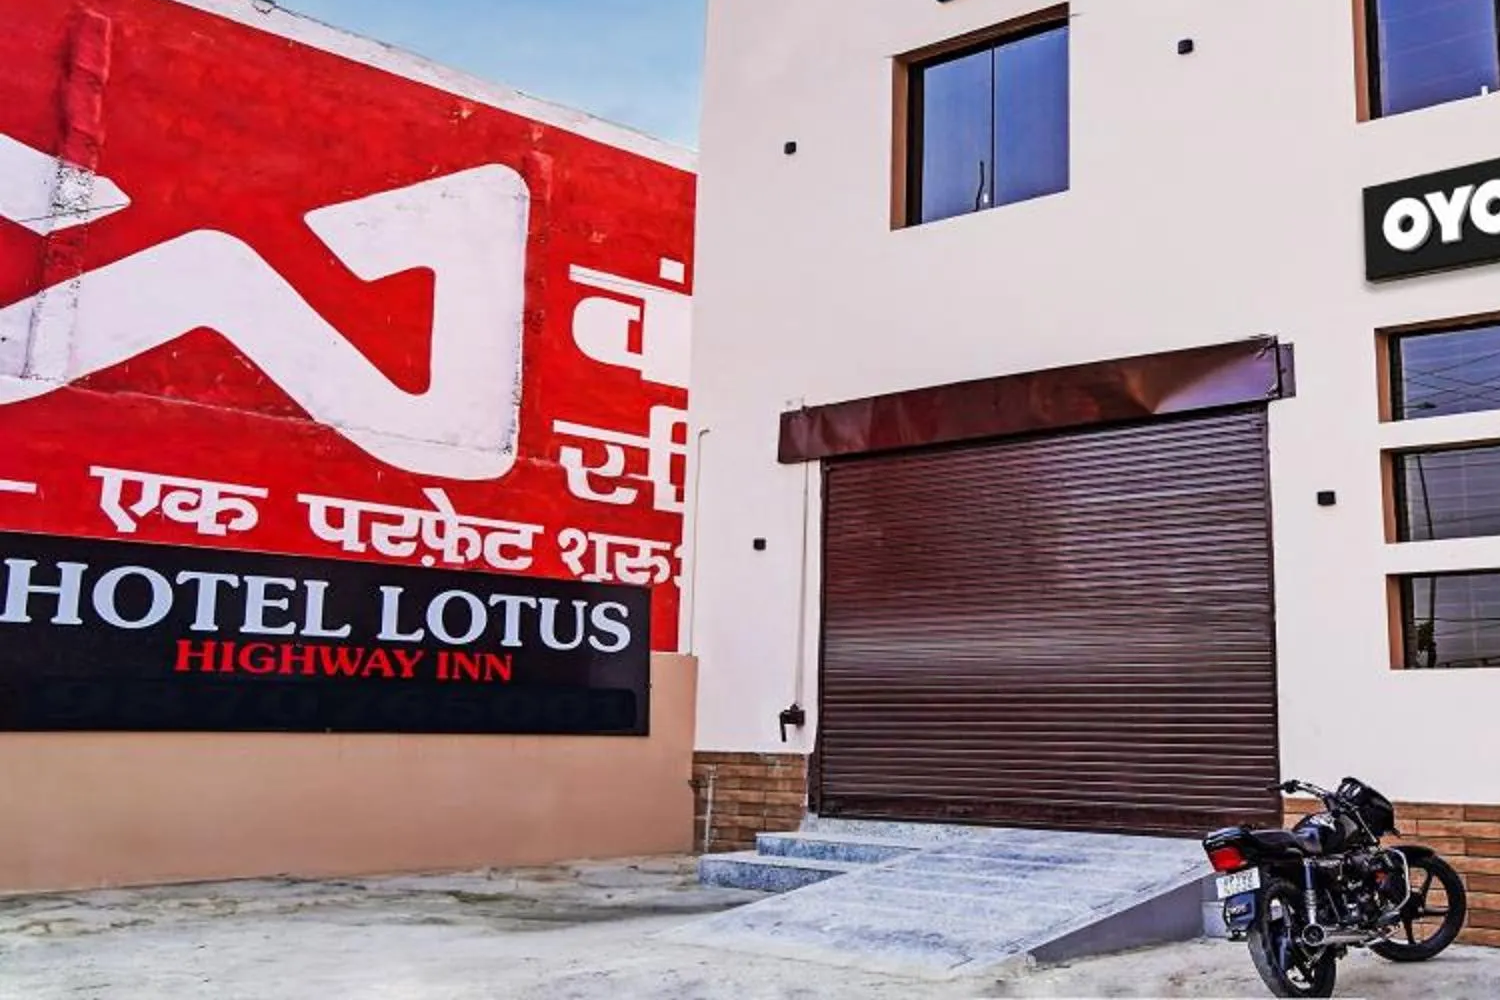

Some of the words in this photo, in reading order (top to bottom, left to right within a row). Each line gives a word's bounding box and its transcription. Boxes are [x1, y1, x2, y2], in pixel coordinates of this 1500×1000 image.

[89, 465, 268, 537] एक
[0, 558, 352, 639] HOTEL
[377, 585, 631, 653] LOTUS
[174, 639, 423, 680] HIGHWAY
[436, 651, 513, 681] INN
